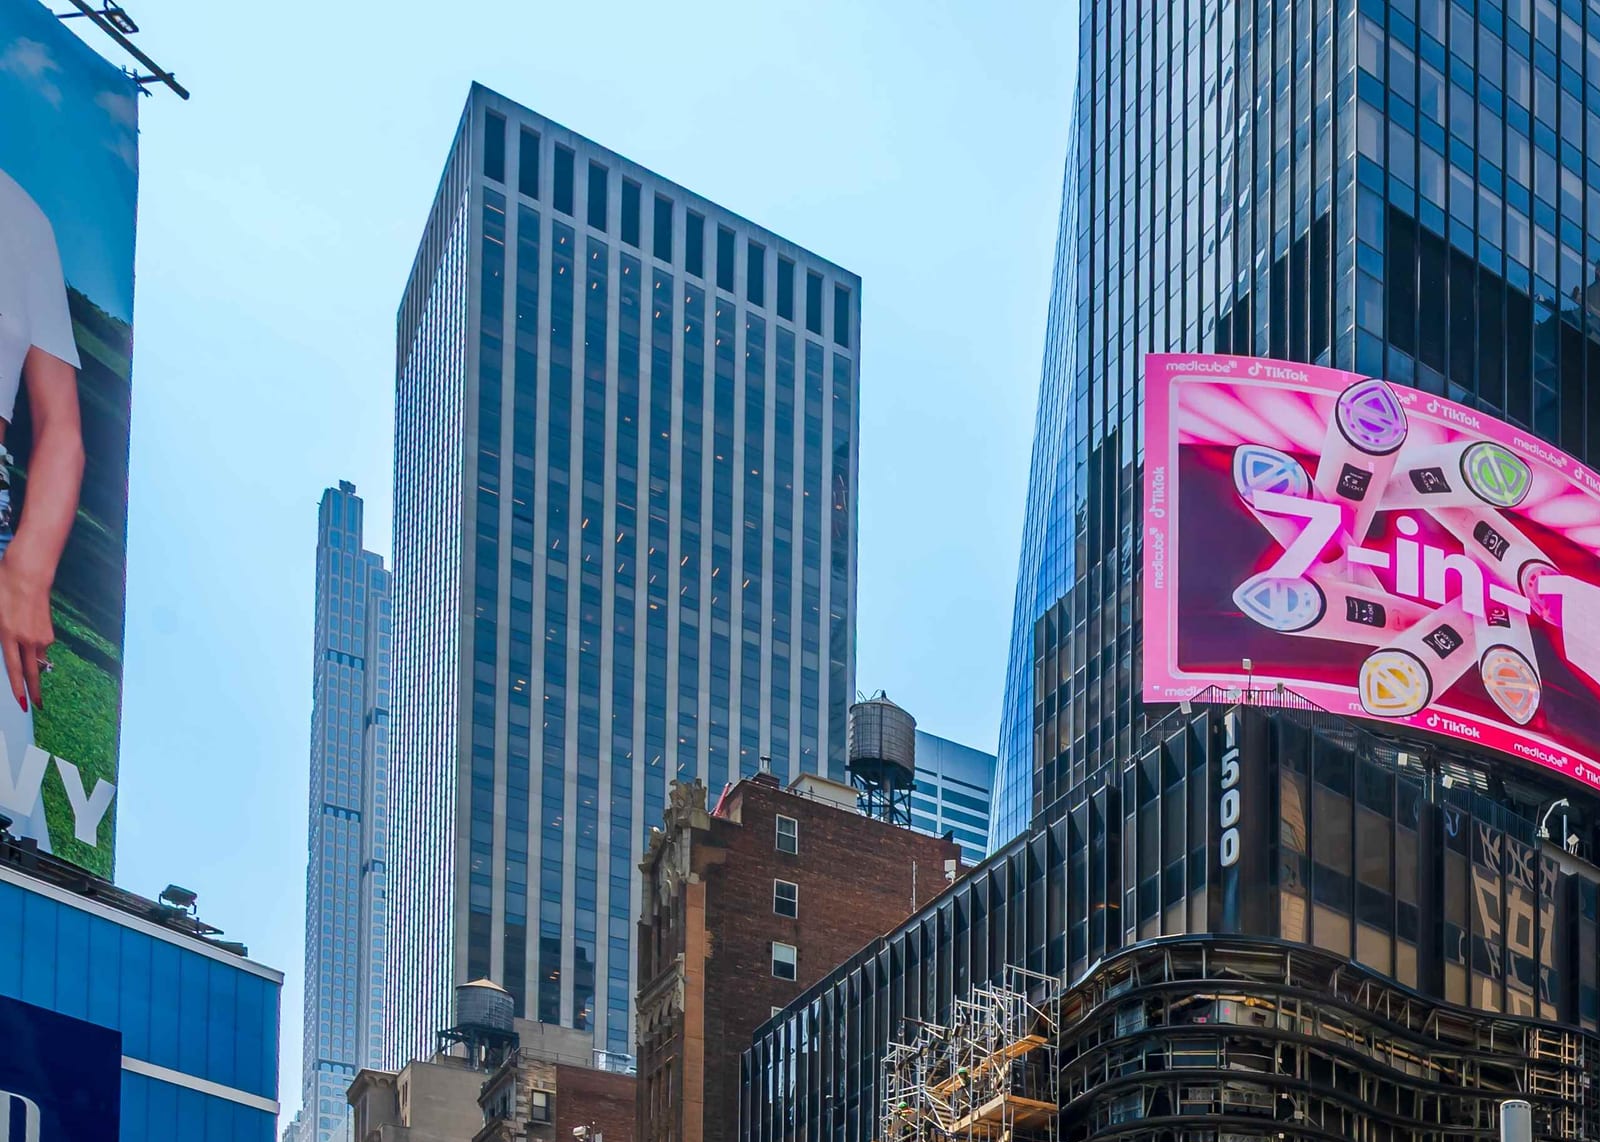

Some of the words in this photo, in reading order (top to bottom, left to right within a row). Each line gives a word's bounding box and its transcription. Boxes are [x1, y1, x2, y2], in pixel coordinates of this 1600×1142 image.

[1166, 361, 1230, 374] medicube
[1264, 366, 1309, 382] TikTok
[1440, 406, 1480, 429] TikTok
[1513, 436, 1562, 468] medicube
[1152, 466, 1165, 510] TikTok
[1152, 533, 1165, 589] medicube
[1441, 719, 1481, 739] TikTok
[1513, 742, 1562, 768] medicube
[1220, 712, 1240, 868] 1500
